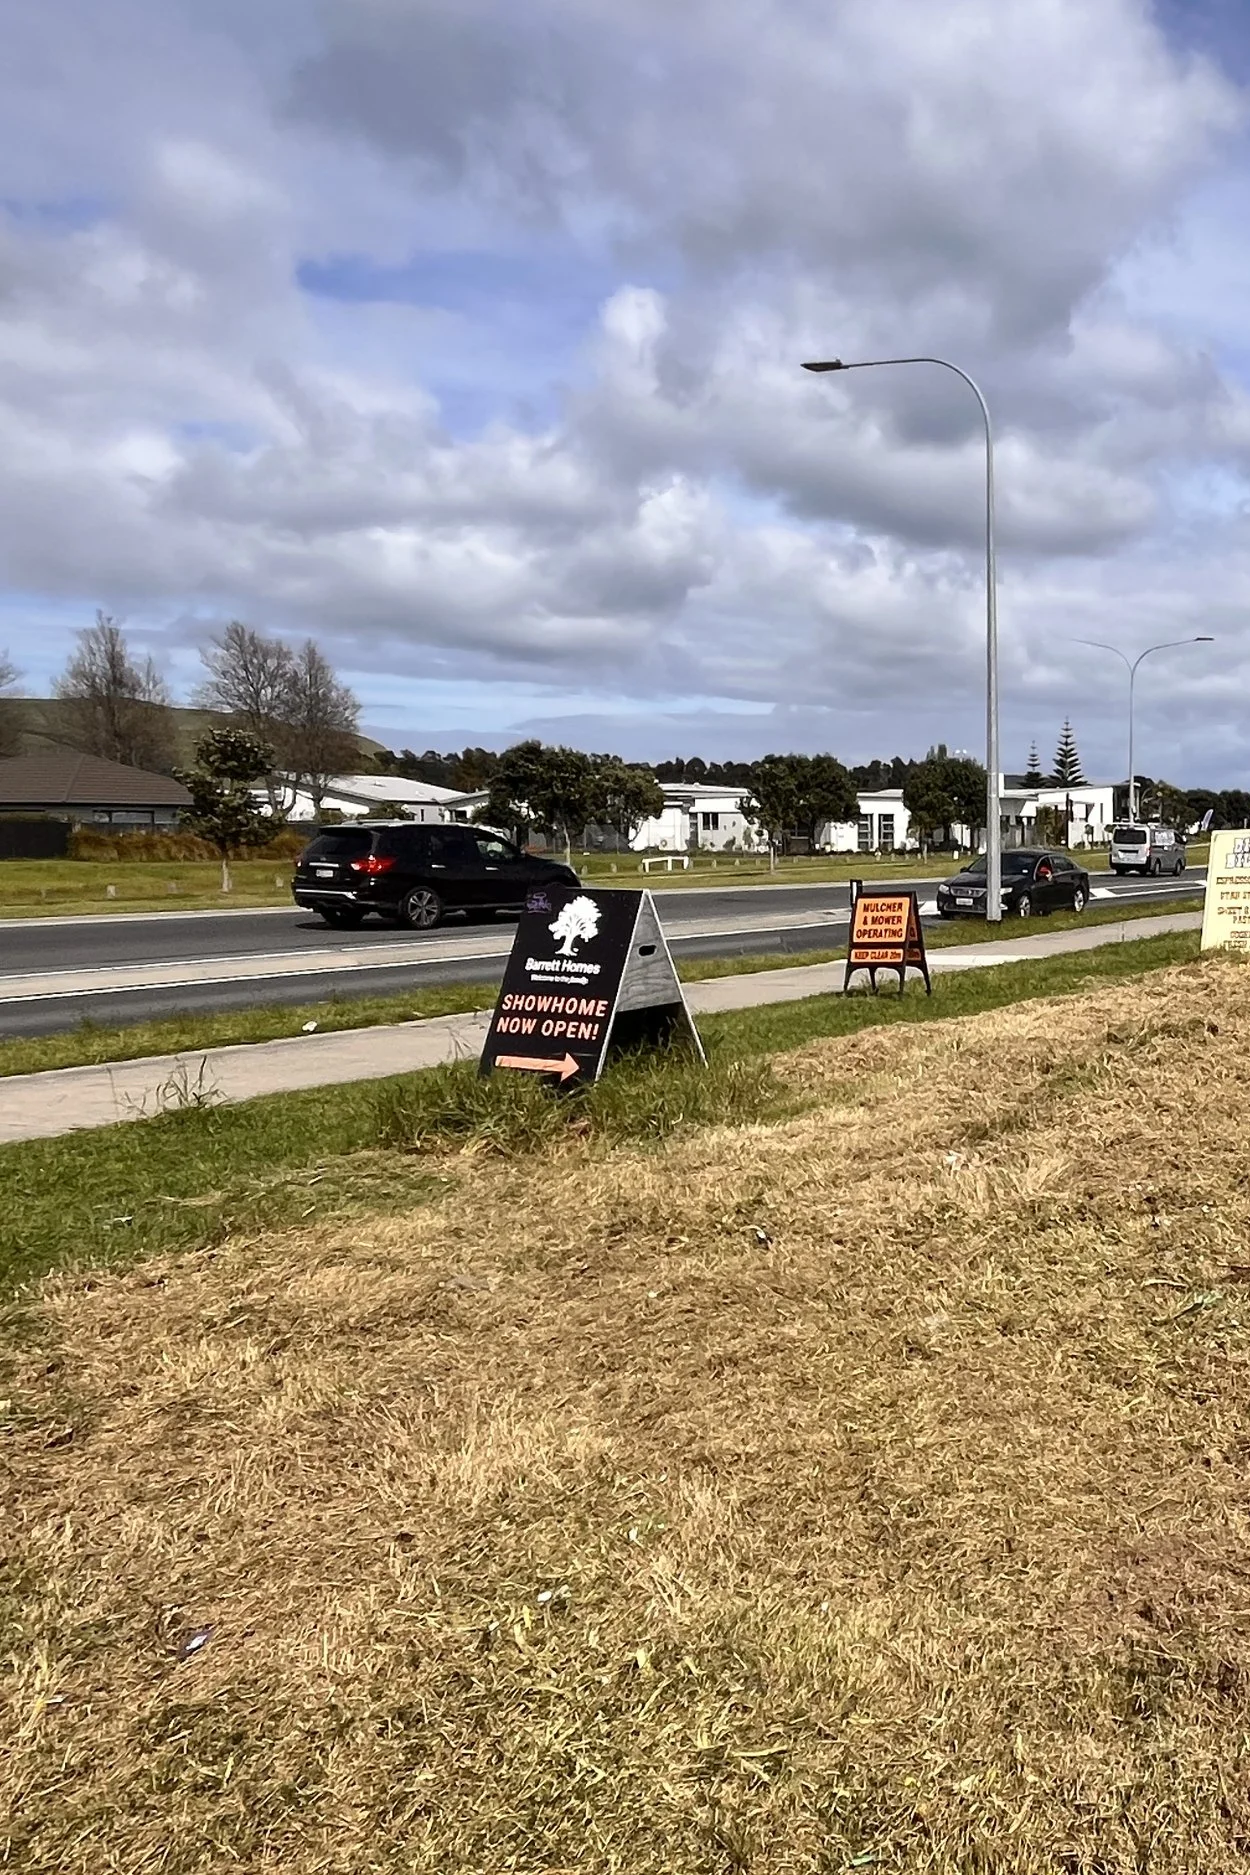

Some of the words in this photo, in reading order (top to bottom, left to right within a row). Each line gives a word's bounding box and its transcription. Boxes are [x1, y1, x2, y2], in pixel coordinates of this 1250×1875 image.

[863, 902, 903, 913] MULCHER
[862, 915, 868, 926] &
[871, 915, 902, 925] MOWER
[856, 928, 903, 939] OPERATING
[854, 951, 869, 960] KEEP
[870, 951, 889, 960] CLEAR
[525, 957, 561, 972] Barrett
[561, 959, 601, 975] Homes
[502, 993, 609, 1017] SHOWHOME
[496, 1016, 538, 1035] NOW
[540, 1019, 600, 1041] OPEN!
